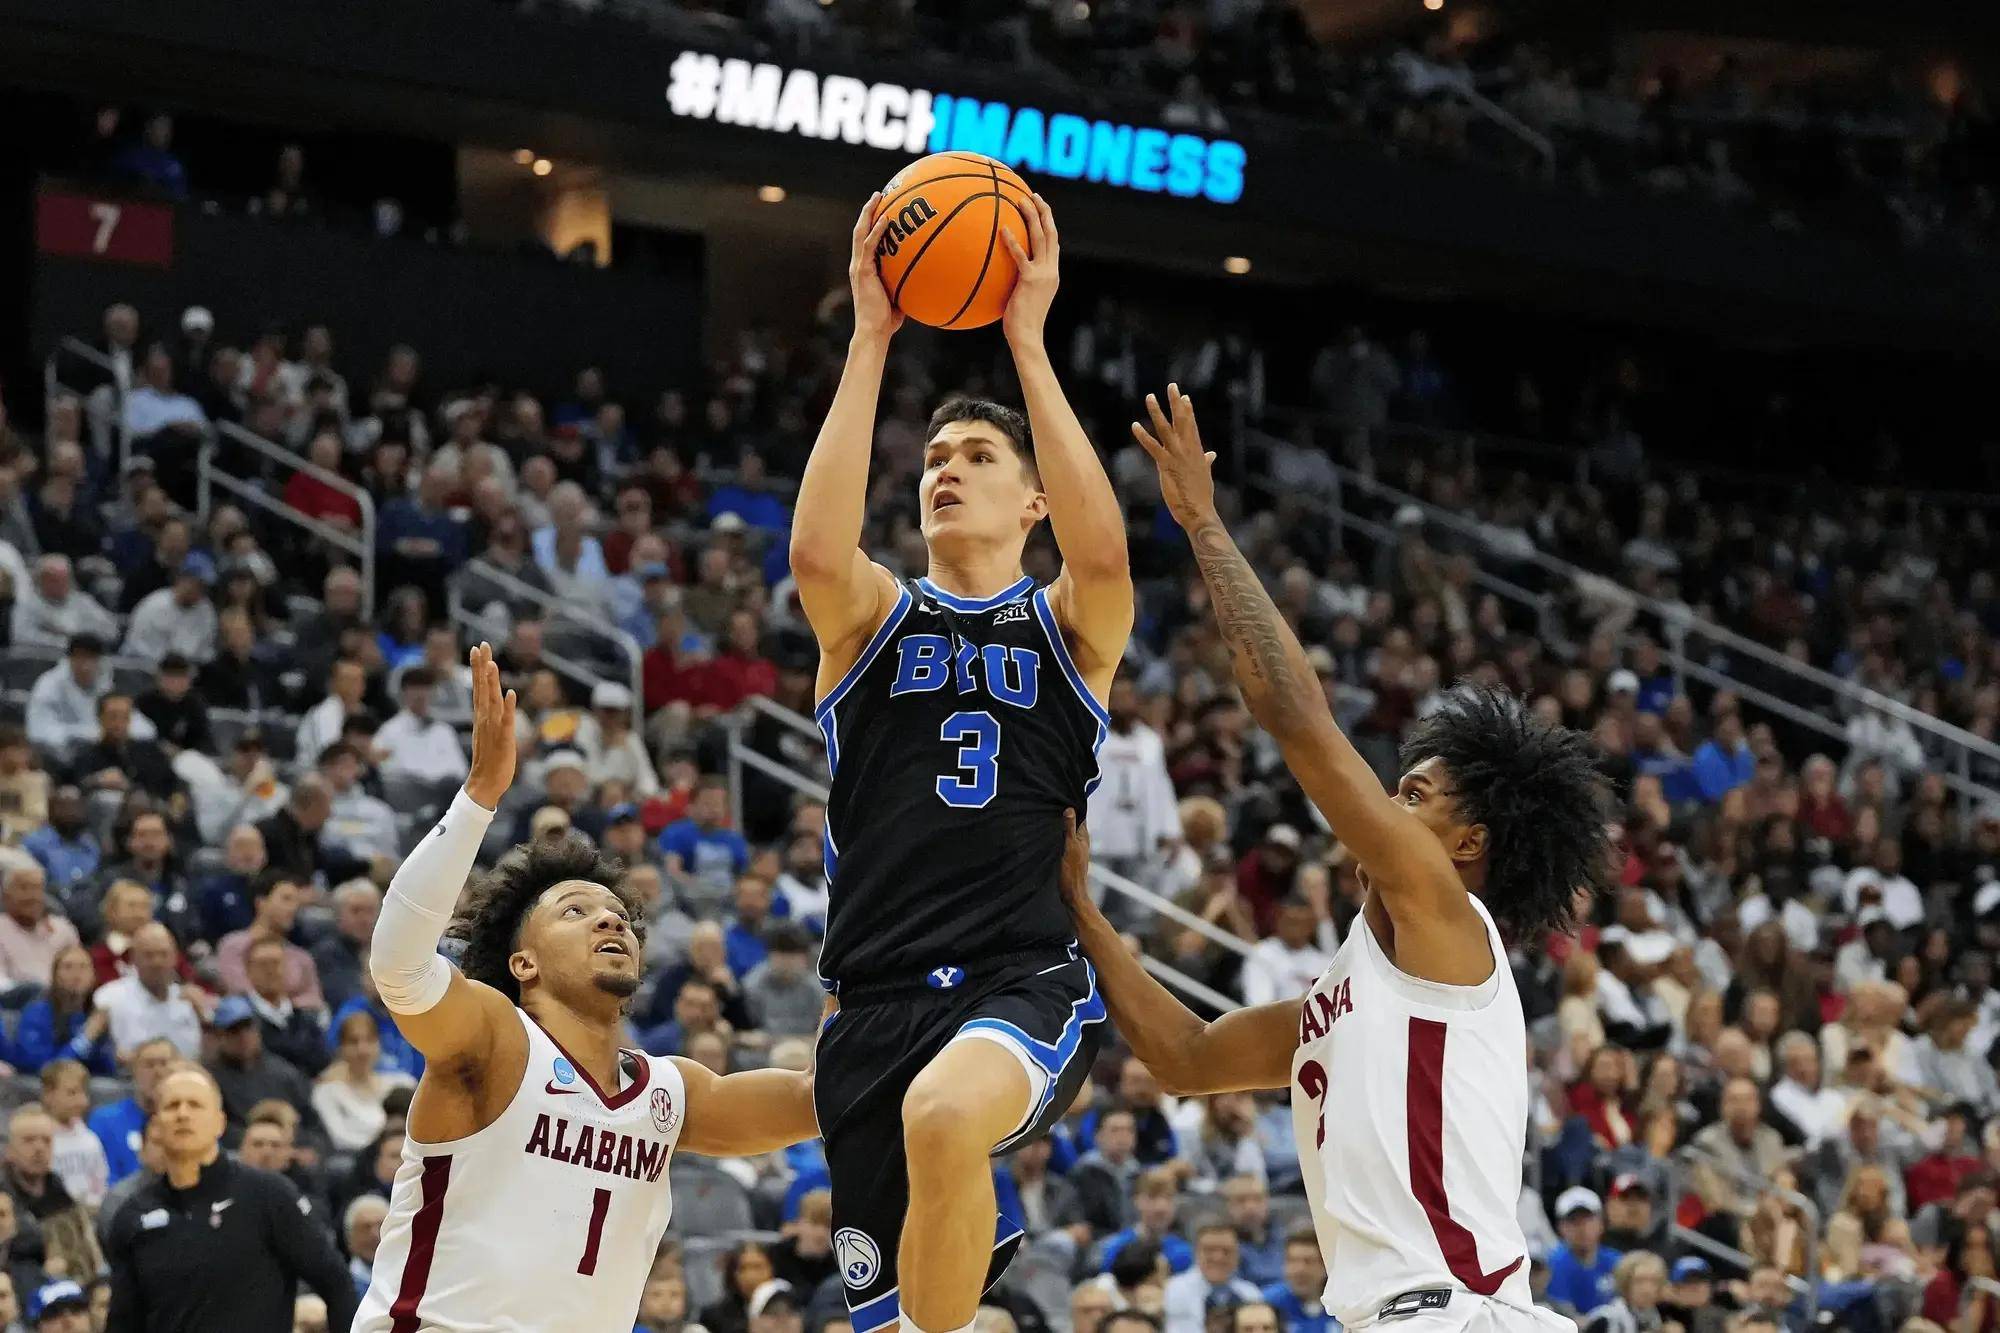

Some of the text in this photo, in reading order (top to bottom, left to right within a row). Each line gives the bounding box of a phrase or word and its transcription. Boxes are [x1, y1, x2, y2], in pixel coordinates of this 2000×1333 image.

[89, 203, 121, 253] 7
[889, 634, 1041, 709] BYU
[936, 710, 1001, 808] 3
[932, 966, 958, 987] Y
[525, 1113, 670, 1183] ALABAMA
[577, 1187, 612, 1277] 1
[849, 1263, 864, 1279] Y
[1425, 1295, 1438, 1304] 44
